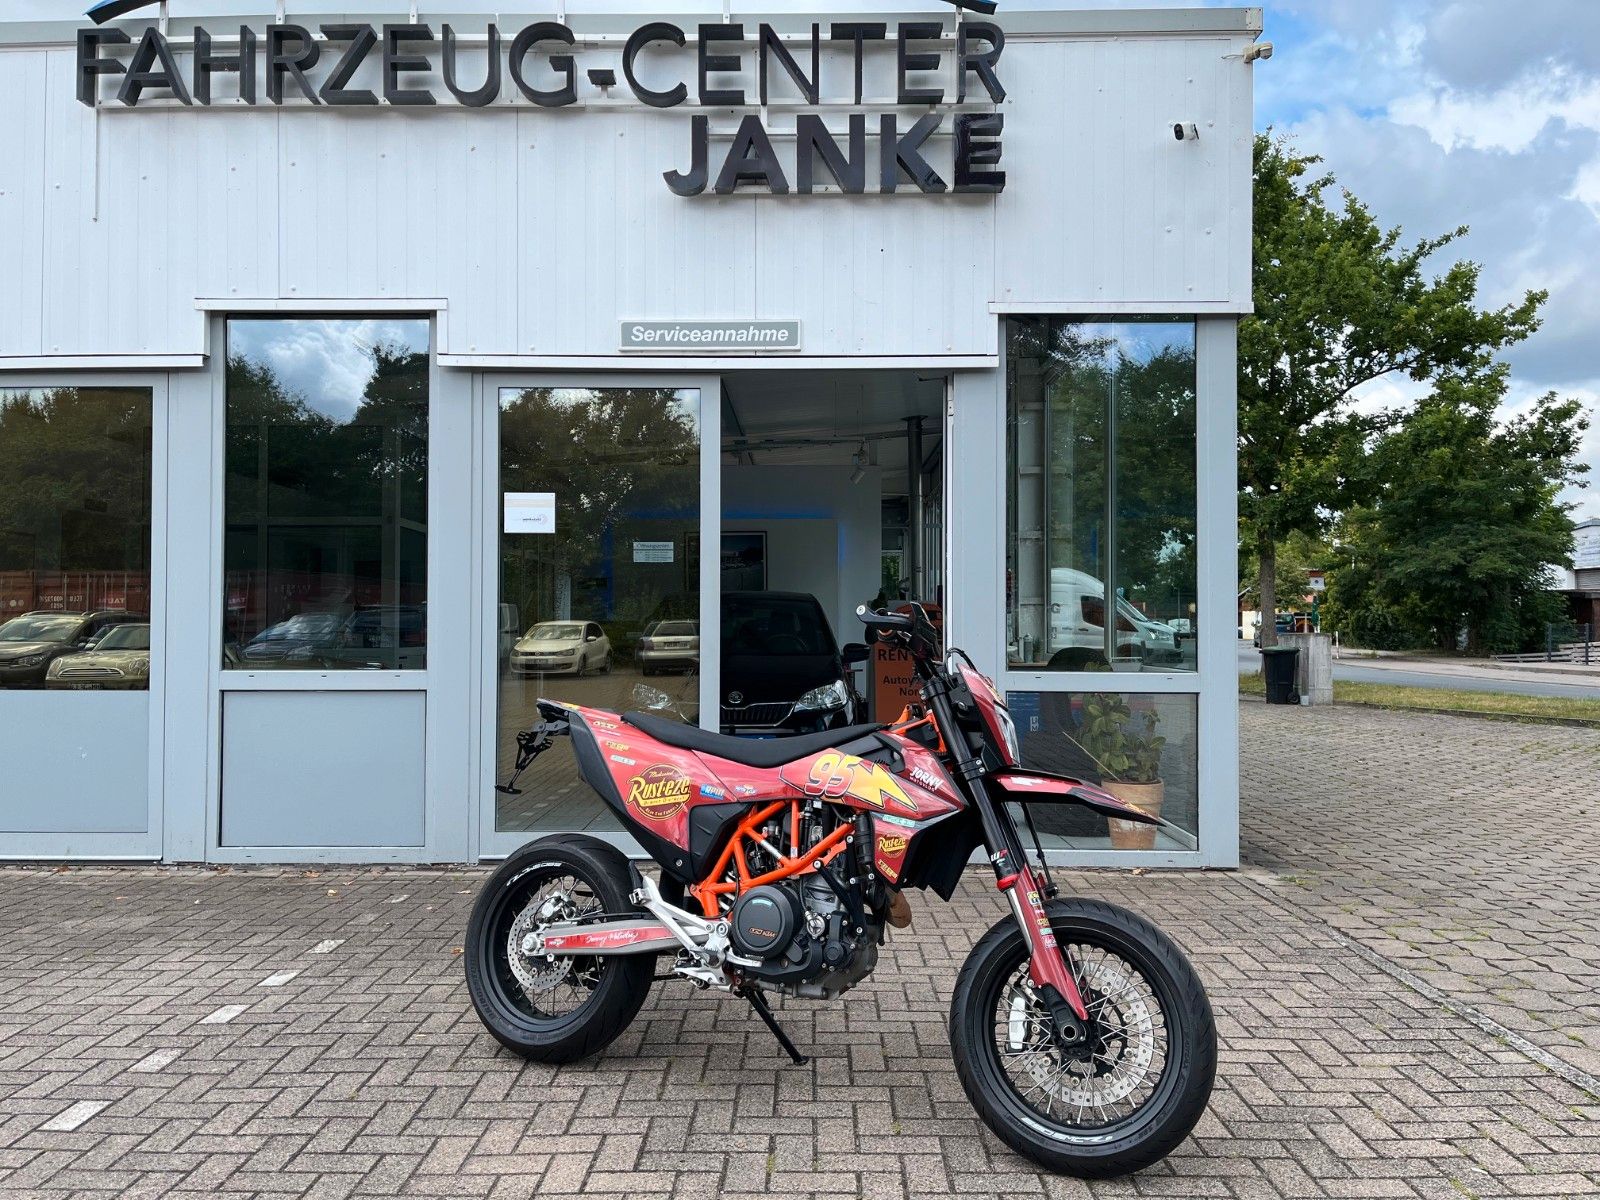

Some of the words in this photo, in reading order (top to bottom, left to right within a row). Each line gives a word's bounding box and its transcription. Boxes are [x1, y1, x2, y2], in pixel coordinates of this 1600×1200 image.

[77, 22, 1006, 107] FAHRZEUG-CENTER
[663, 113, 1006, 196] JANKE
[631, 325, 789, 342] Serviceannahme
[878, 648, 908, 661] REN
[804, 753, 861, 797] 95
